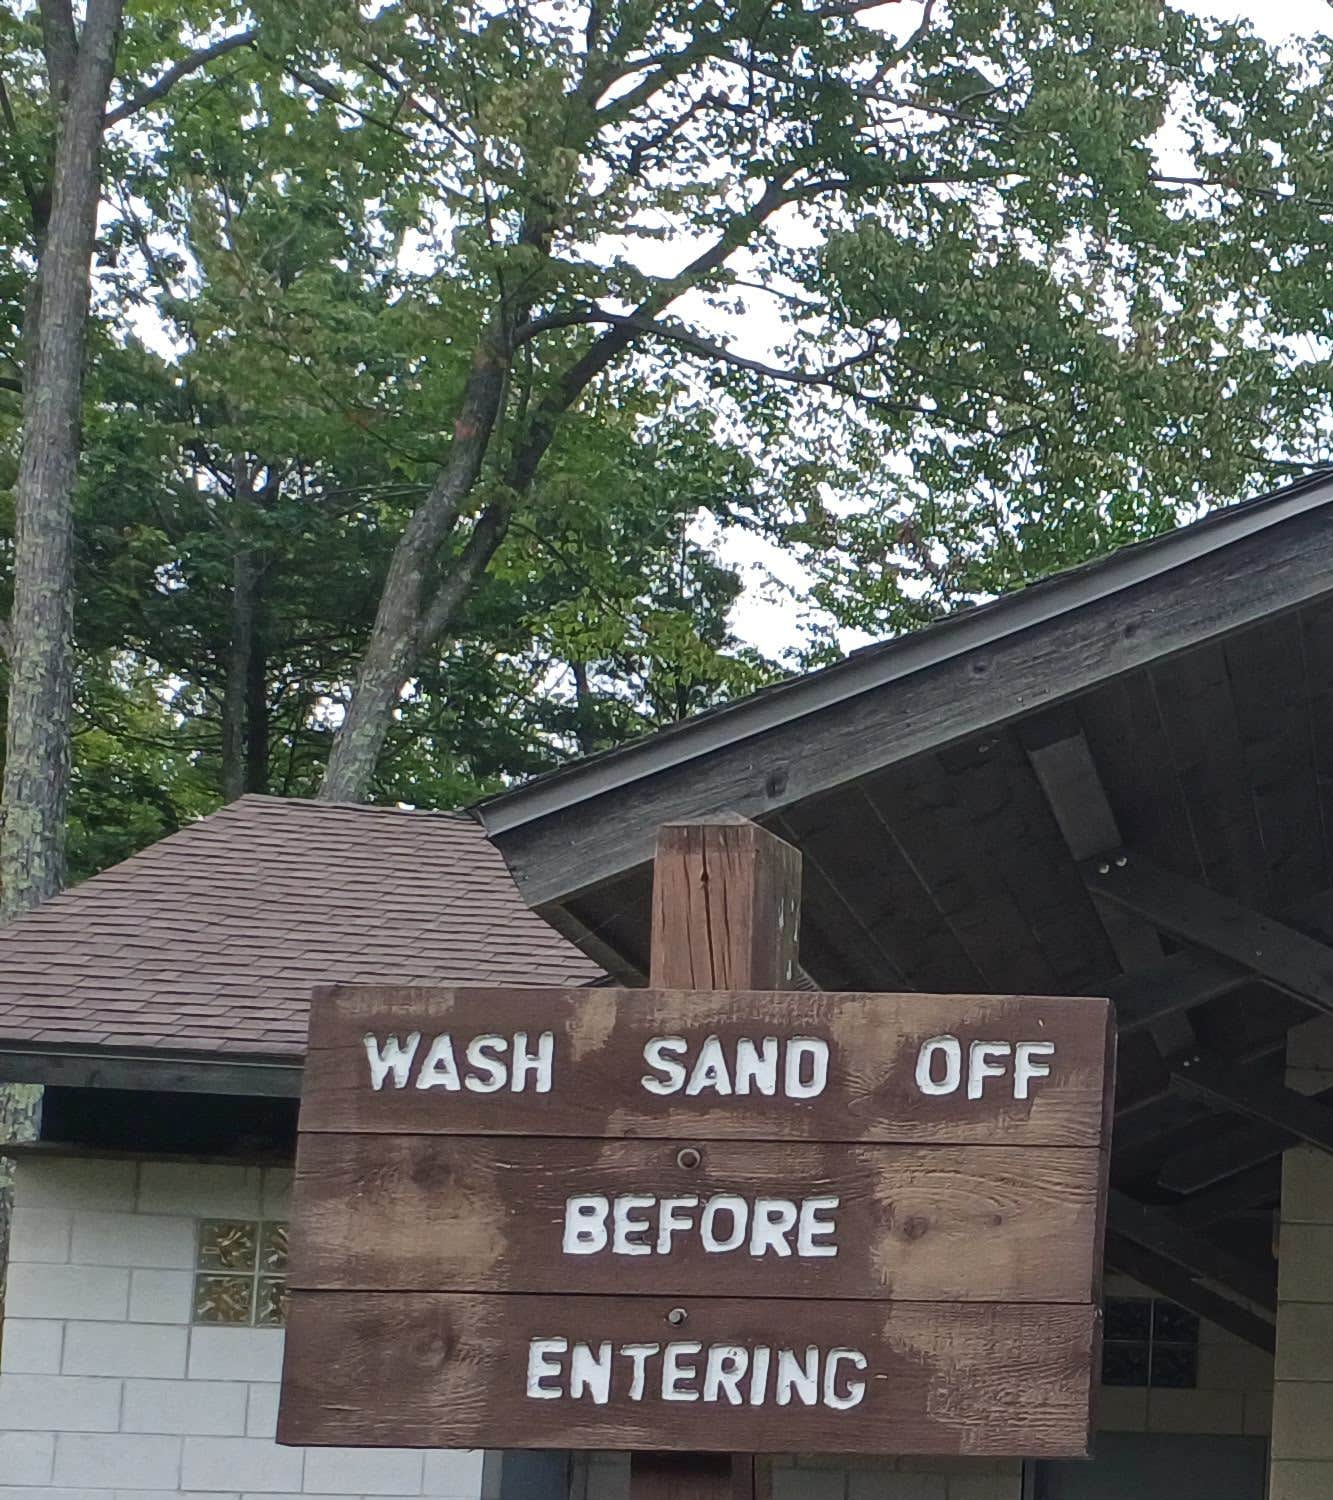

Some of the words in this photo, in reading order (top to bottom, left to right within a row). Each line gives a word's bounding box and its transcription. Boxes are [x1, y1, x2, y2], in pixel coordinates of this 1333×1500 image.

[362, 1031, 556, 1093] WASH
[640, 1035, 831, 1099] SAND
[914, 1035, 1057, 1100] OFF
[561, 1194, 840, 1257] BEFORE
[525, 1337, 869, 1410] ENTERING
